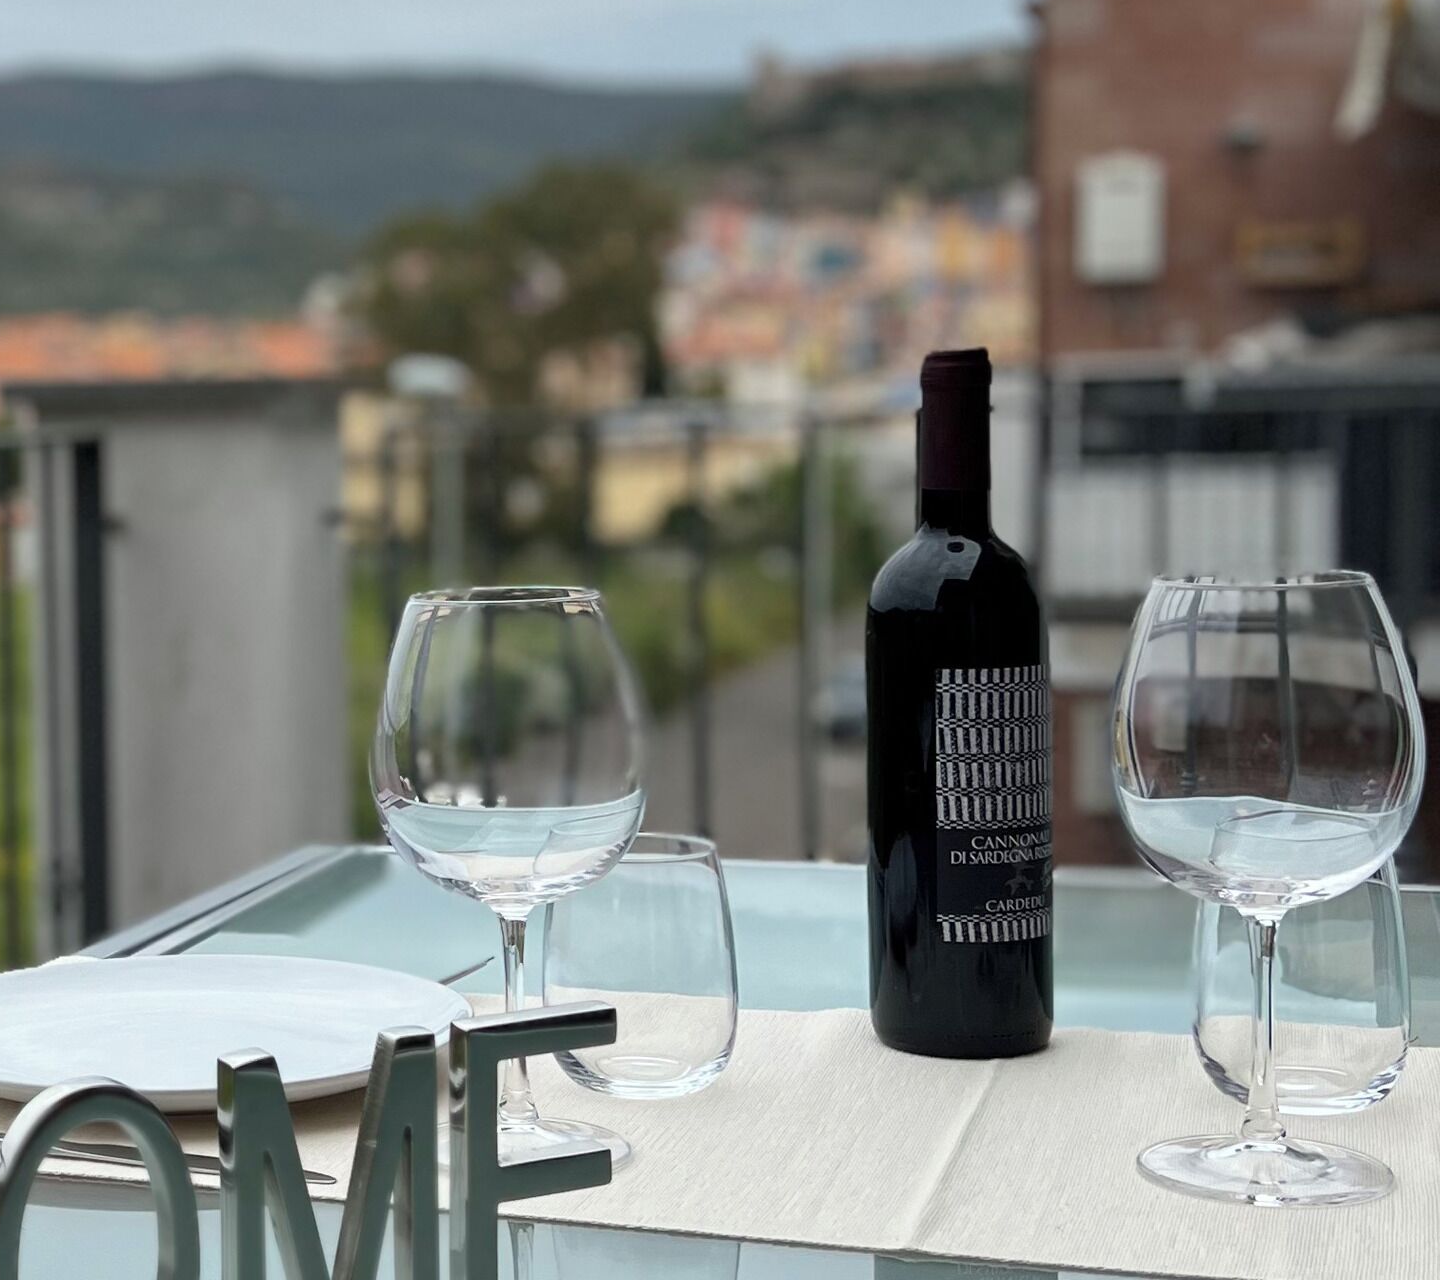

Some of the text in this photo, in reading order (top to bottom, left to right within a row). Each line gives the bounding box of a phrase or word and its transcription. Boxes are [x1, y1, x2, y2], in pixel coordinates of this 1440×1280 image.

[950, 851, 966, 864] DI
[969, 848, 1033, 864] SARDEGNA
[985, 895, 1044, 912] CARDEDU
